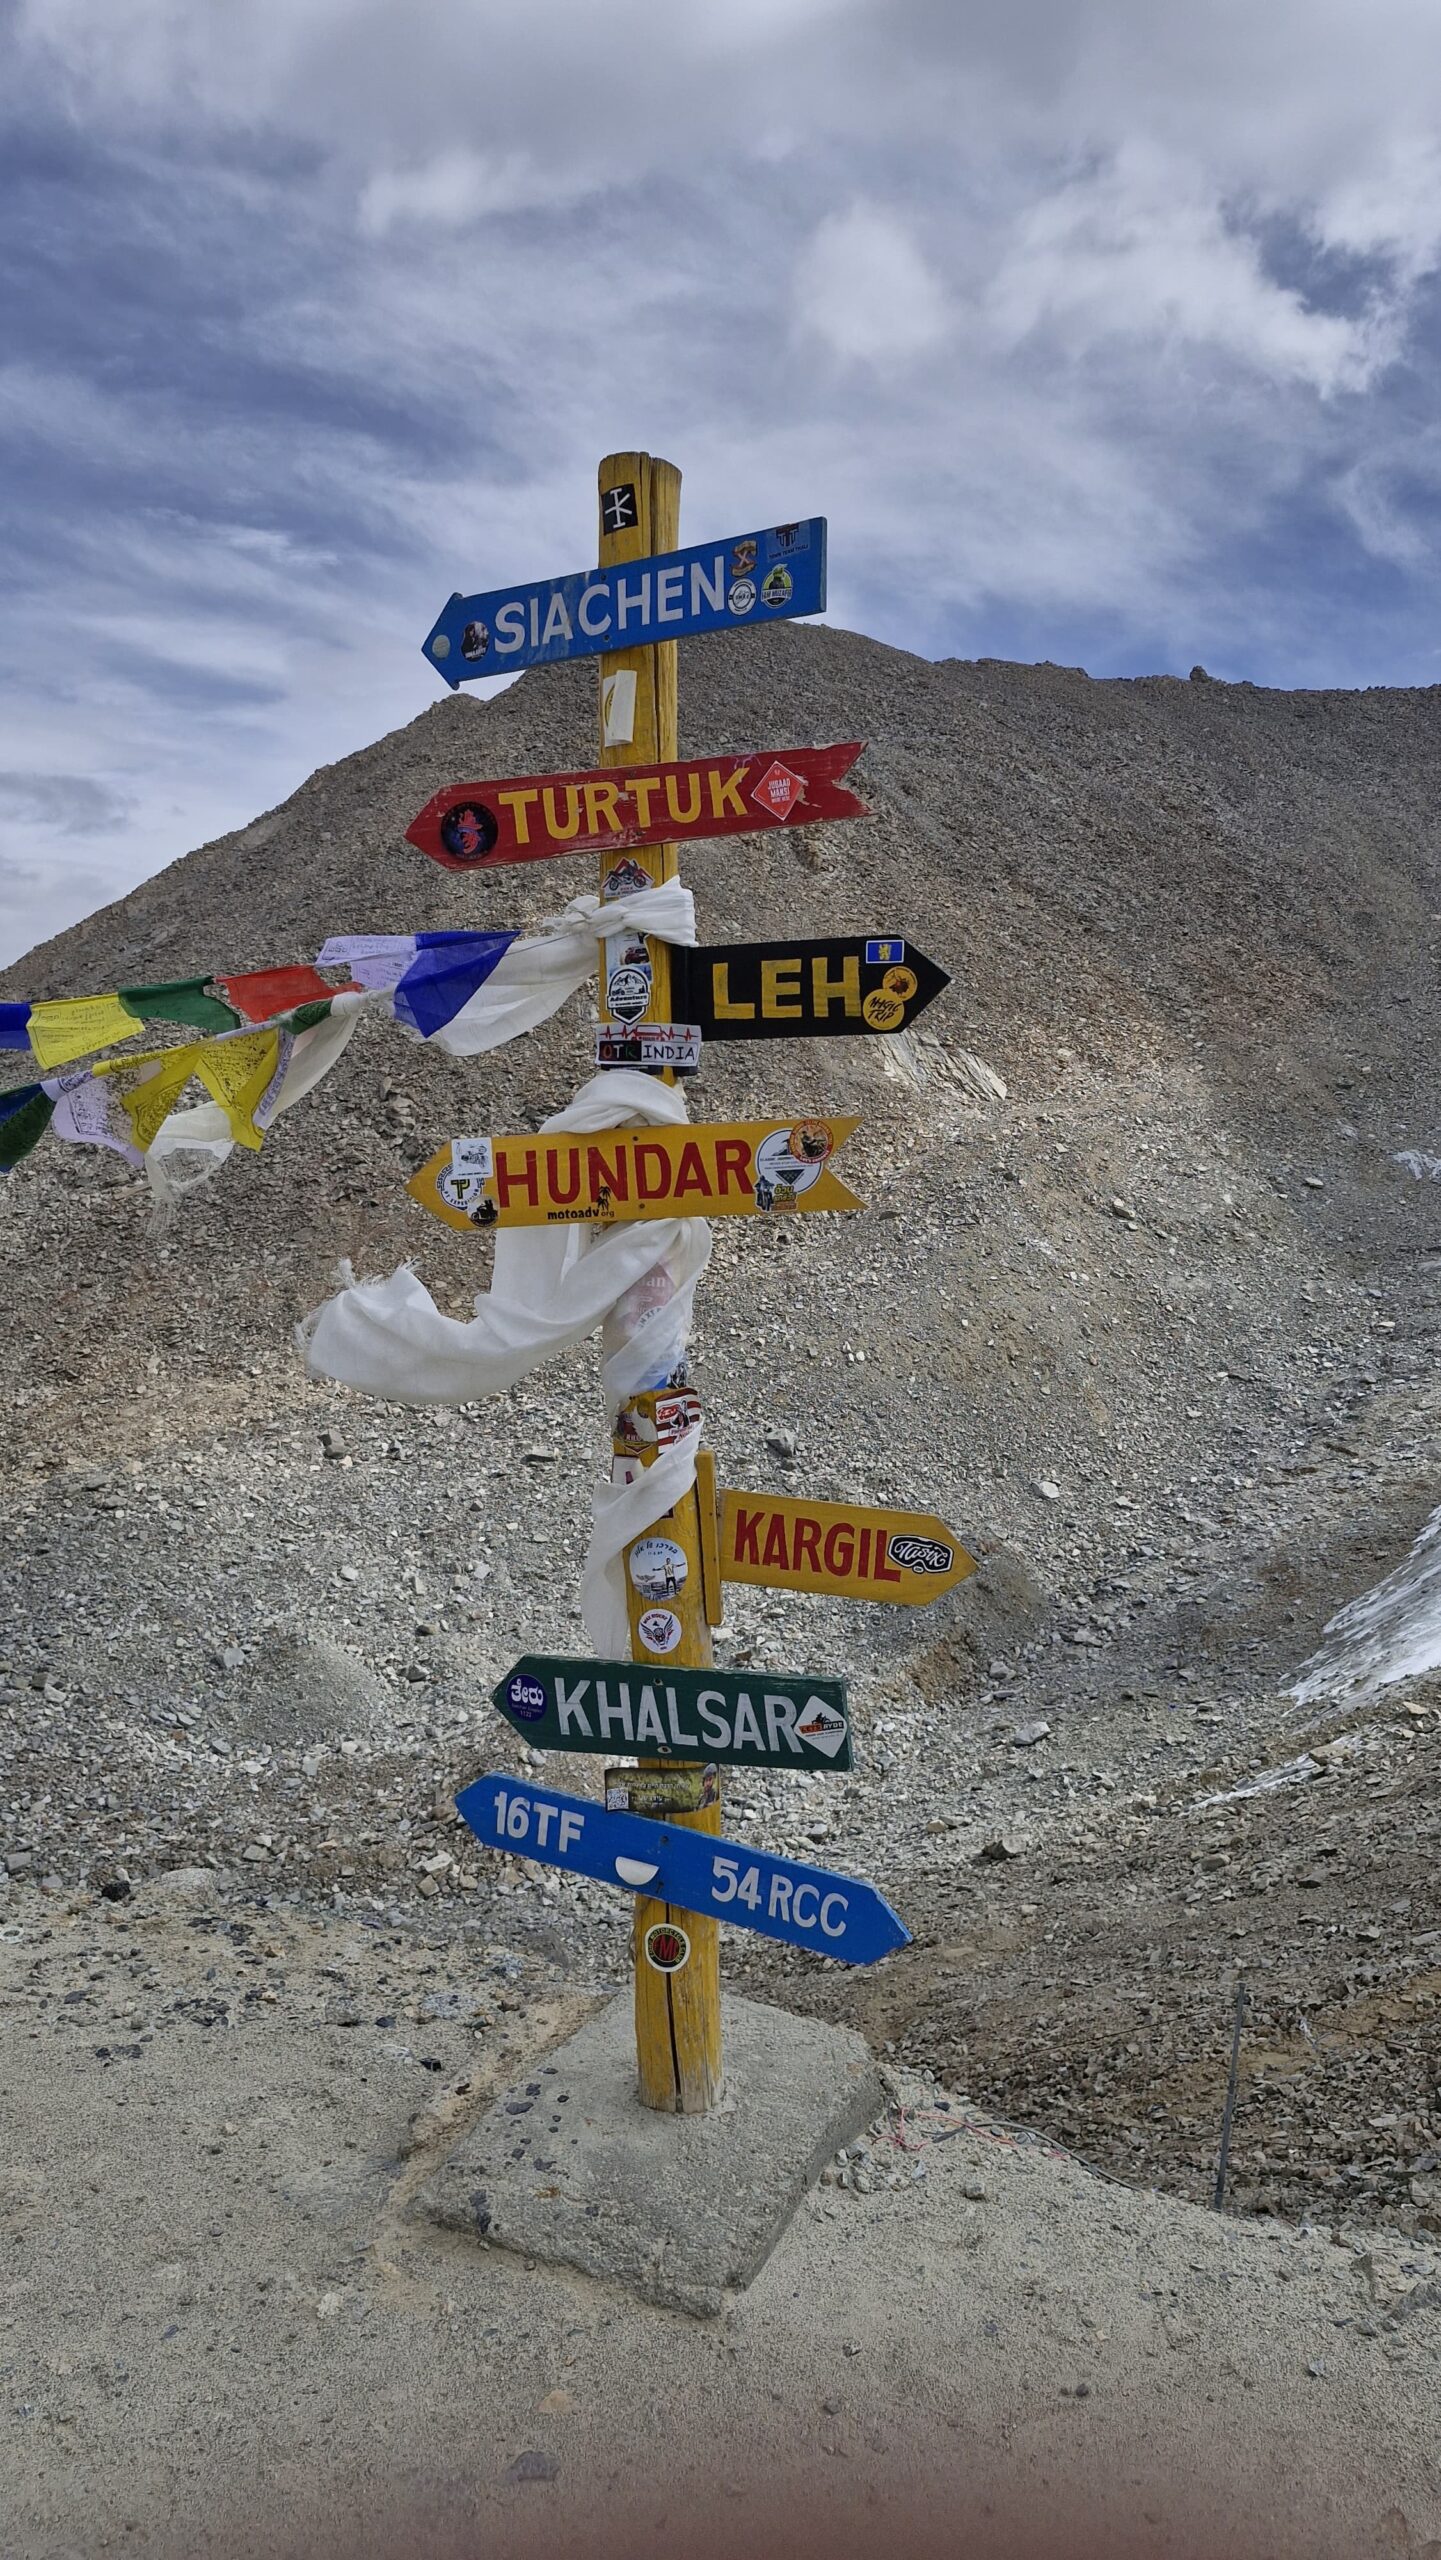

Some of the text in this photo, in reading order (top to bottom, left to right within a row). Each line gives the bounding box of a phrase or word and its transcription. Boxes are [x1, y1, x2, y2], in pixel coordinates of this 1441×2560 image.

[494, 555, 725, 654] SIACHEN
[498, 767, 750, 845] TURTUK
[610, 995, 648, 1003] Adventure
[712, 955, 861, 1021] LEH
[868, 1010, 896, 1023] TRIP
[869, 996, 902, 1012] MAGIC
[642, 1044, 695, 1060] INDIA
[496, 1139, 755, 1208] HUNDAR
[734, 1508, 901, 1583] KARGIL
[554, 1676, 804, 1754] KHALSAR
[493, 1790, 585, 1853] 16TF
